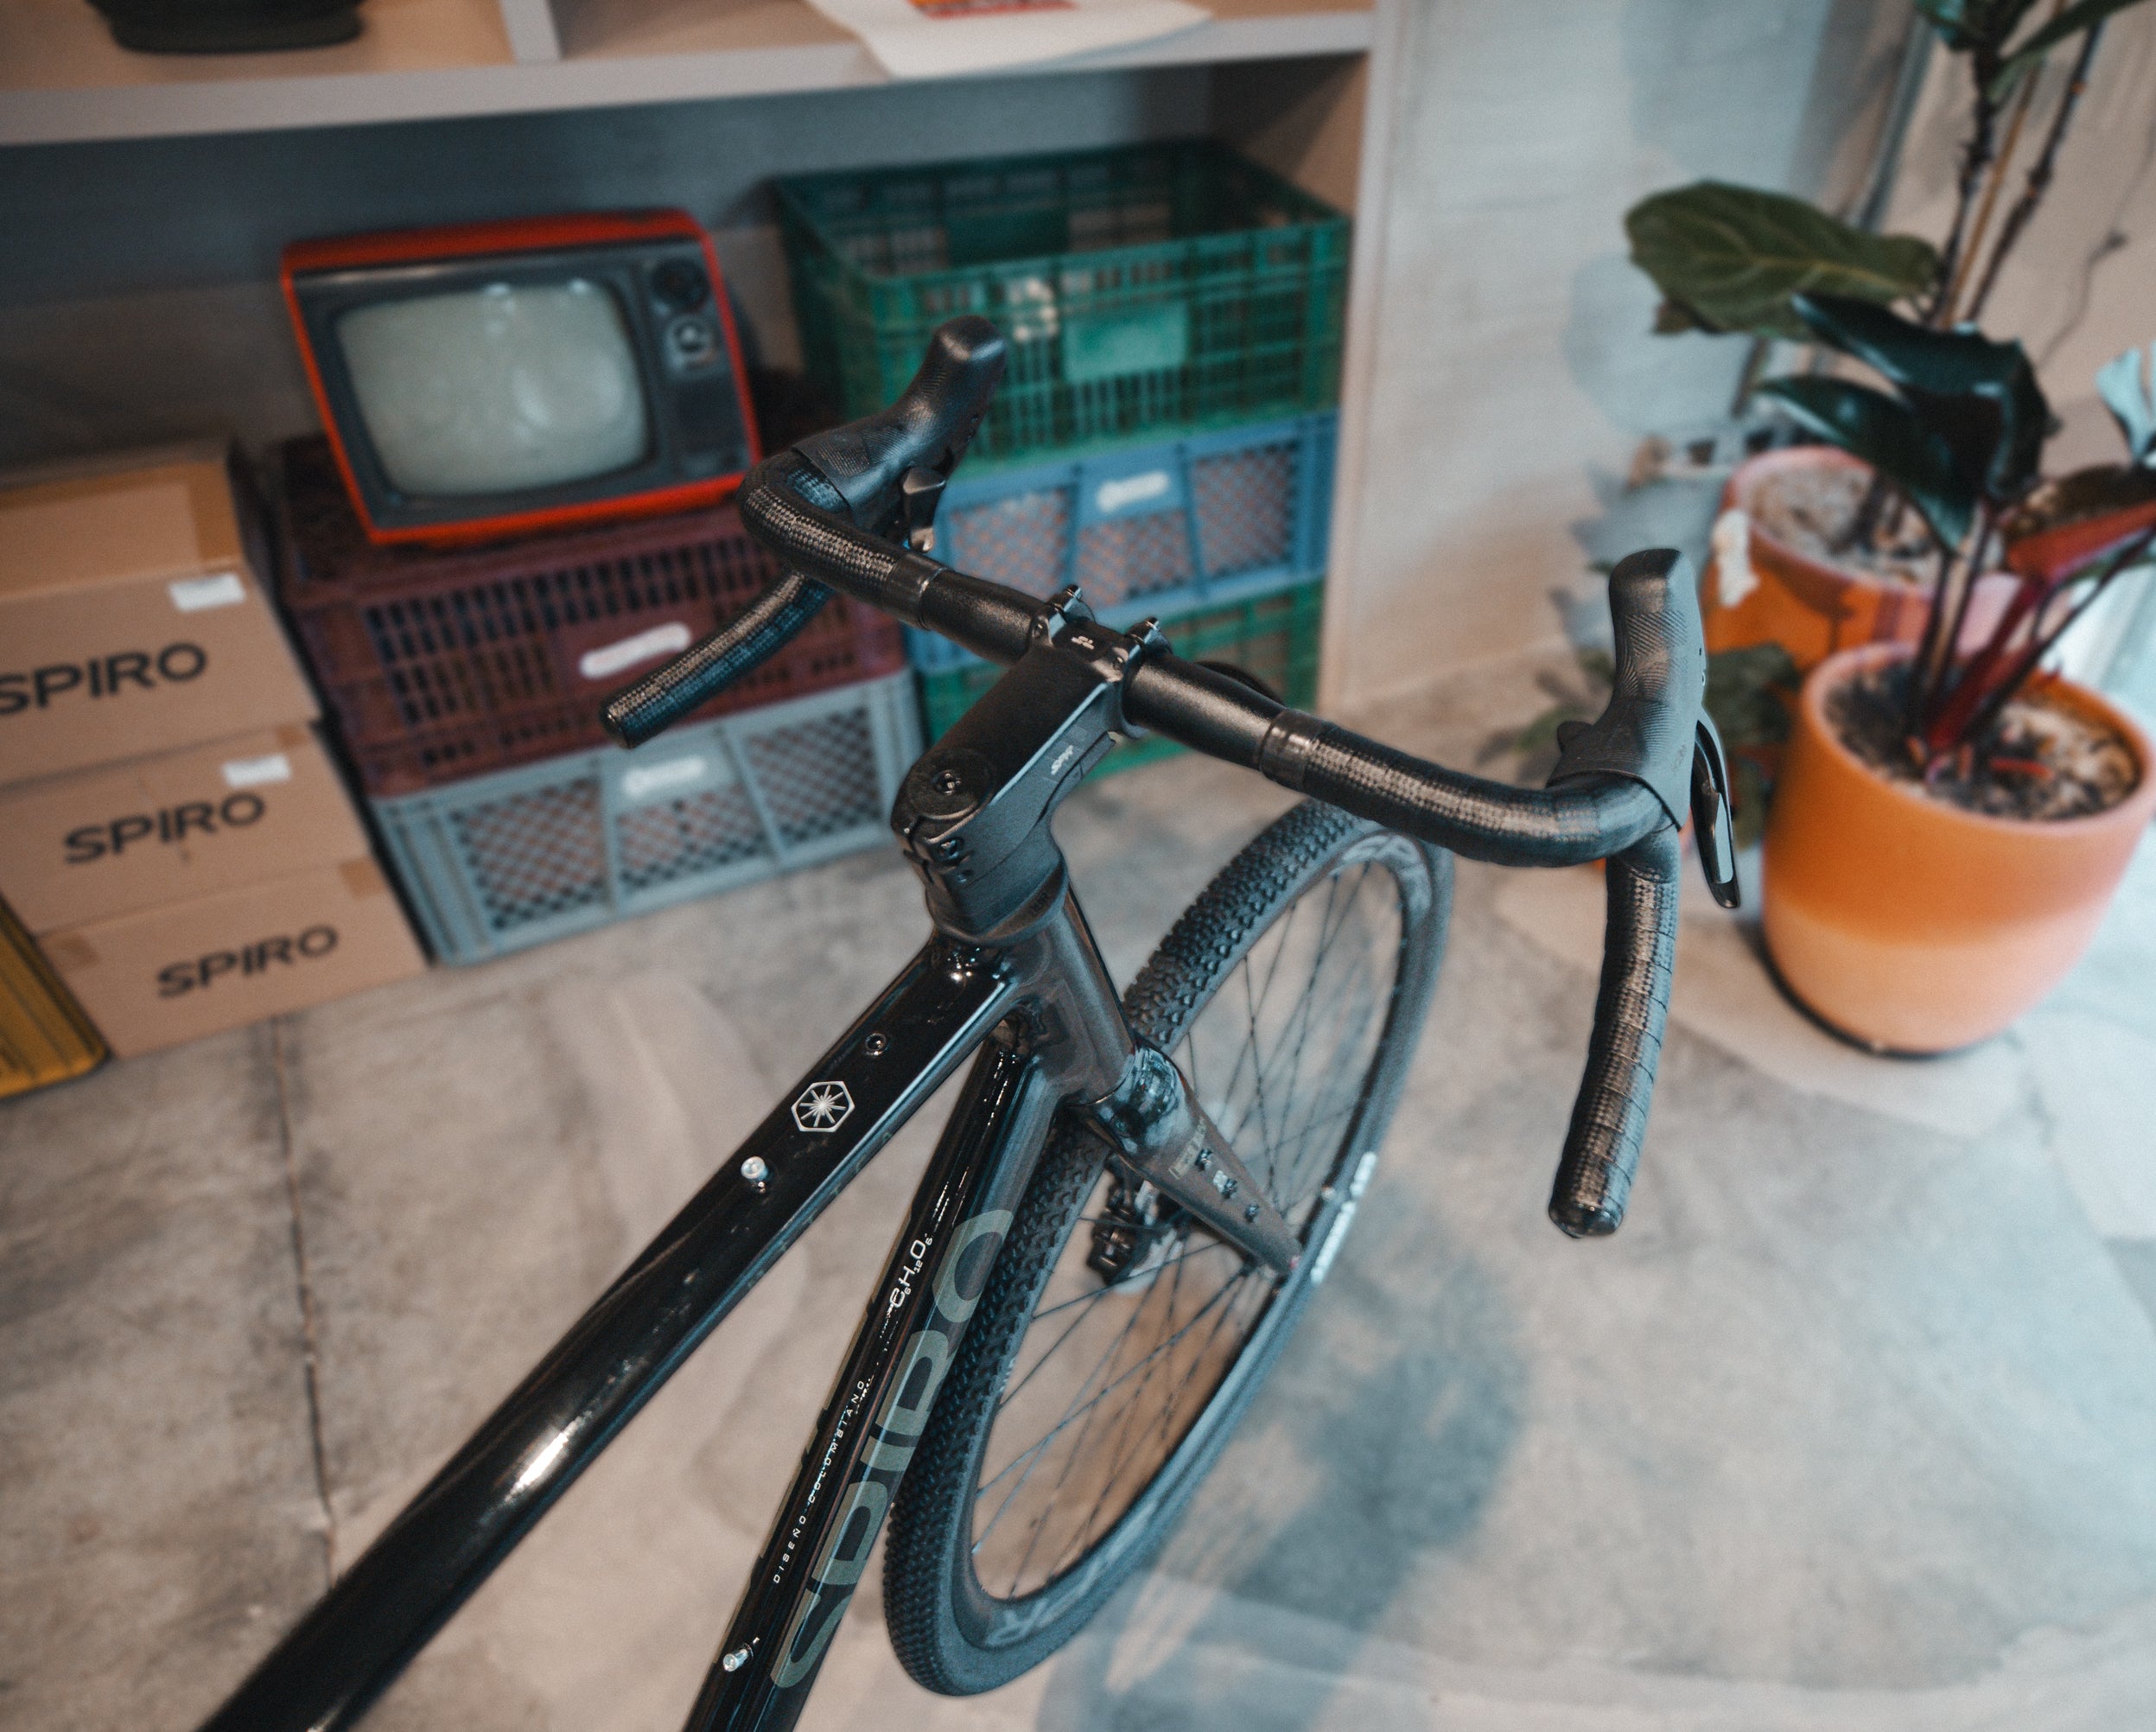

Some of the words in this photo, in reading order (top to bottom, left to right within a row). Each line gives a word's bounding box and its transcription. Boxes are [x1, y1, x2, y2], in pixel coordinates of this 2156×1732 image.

[0, 642, 208, 716] SPIRO
[63, 792, 266, 865] SPIRO
[156, 925, 339, 998] SPIRO
[770, 1209, 1013, 1688] SPIRO
[773, 1514, 807, 1584] DISEÑO
[808, 1379, 865, 1505] COLOMBIANO
